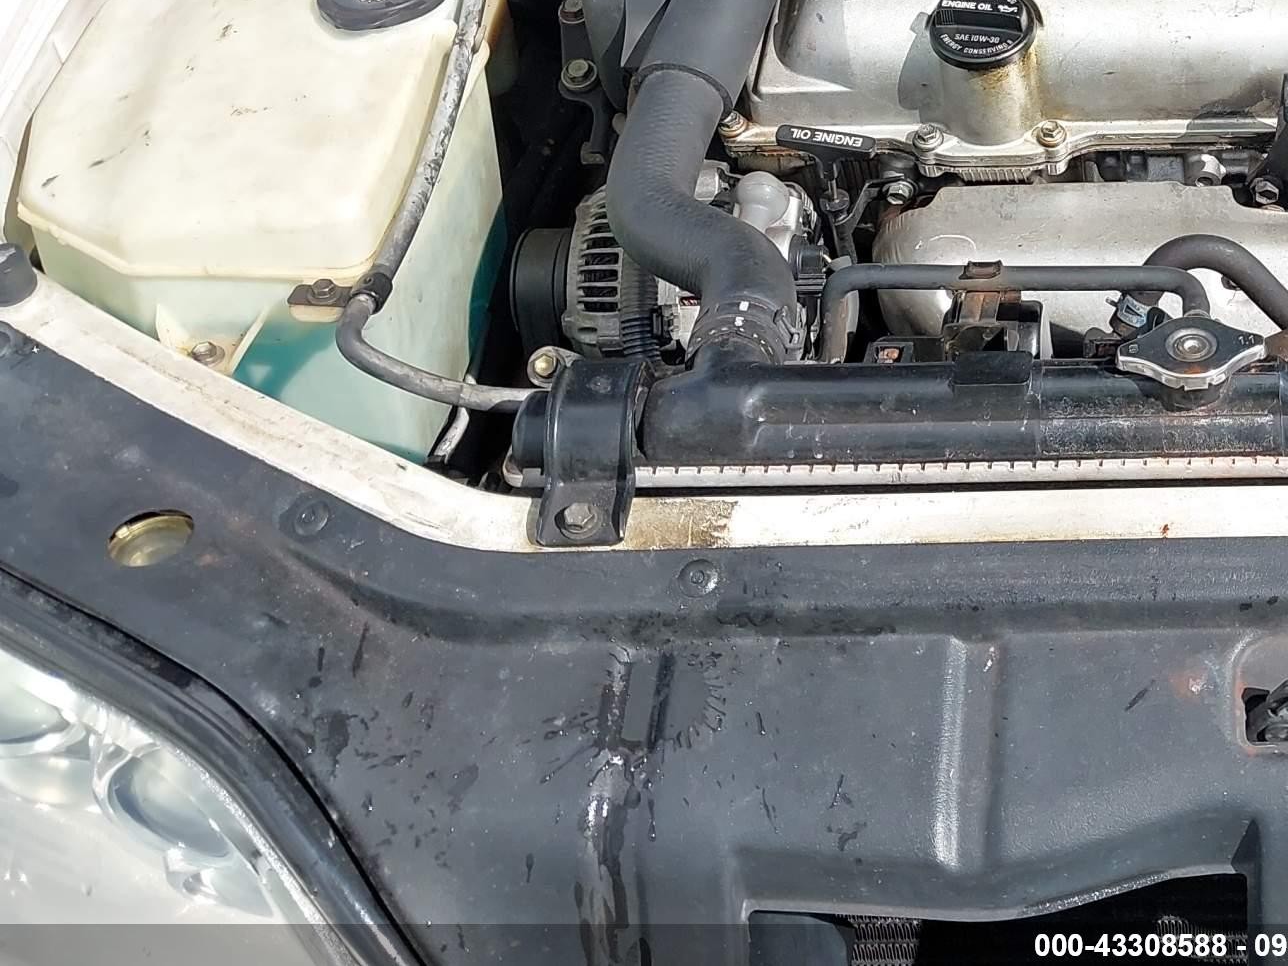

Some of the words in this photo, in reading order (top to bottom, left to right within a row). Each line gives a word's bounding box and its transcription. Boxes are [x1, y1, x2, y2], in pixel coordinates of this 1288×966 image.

[941, 0, 977, 10] ENGINE
[977, 3, 993, 11] OIL
[940, 34, 962, 51] ENERGY
[954, 33, 969, 42] SAE
[790, 128, 811, 140] OIL
[812, 131, 863, 147] ENGINE
[1238, 335, 1256, 346] 1.1
